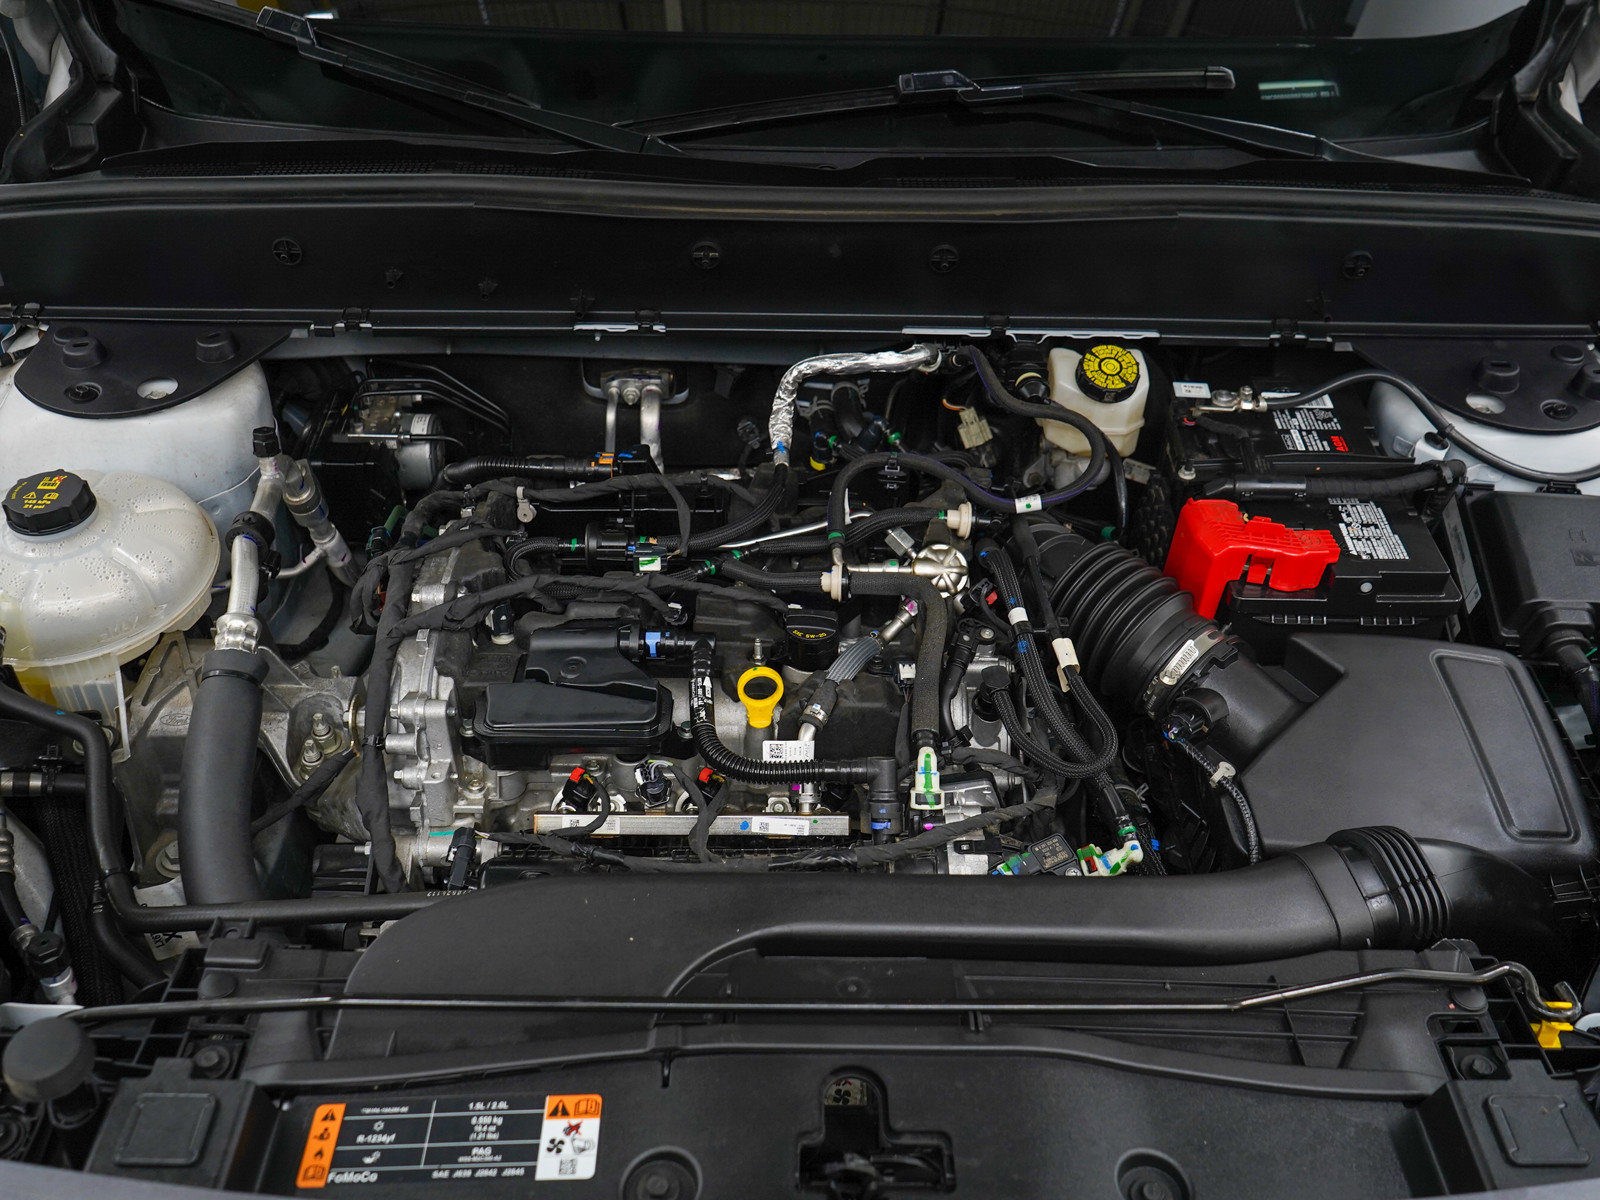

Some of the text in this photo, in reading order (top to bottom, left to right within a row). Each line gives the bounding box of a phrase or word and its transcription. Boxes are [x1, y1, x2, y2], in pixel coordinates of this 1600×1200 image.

[356, 1132, 397, 1144] R-1234yf
[471, 1146, 493, 1156] PAG
[327, 1170, 379, 1184] FoMoCo
[431, 1169, 451, 1179] SAE
